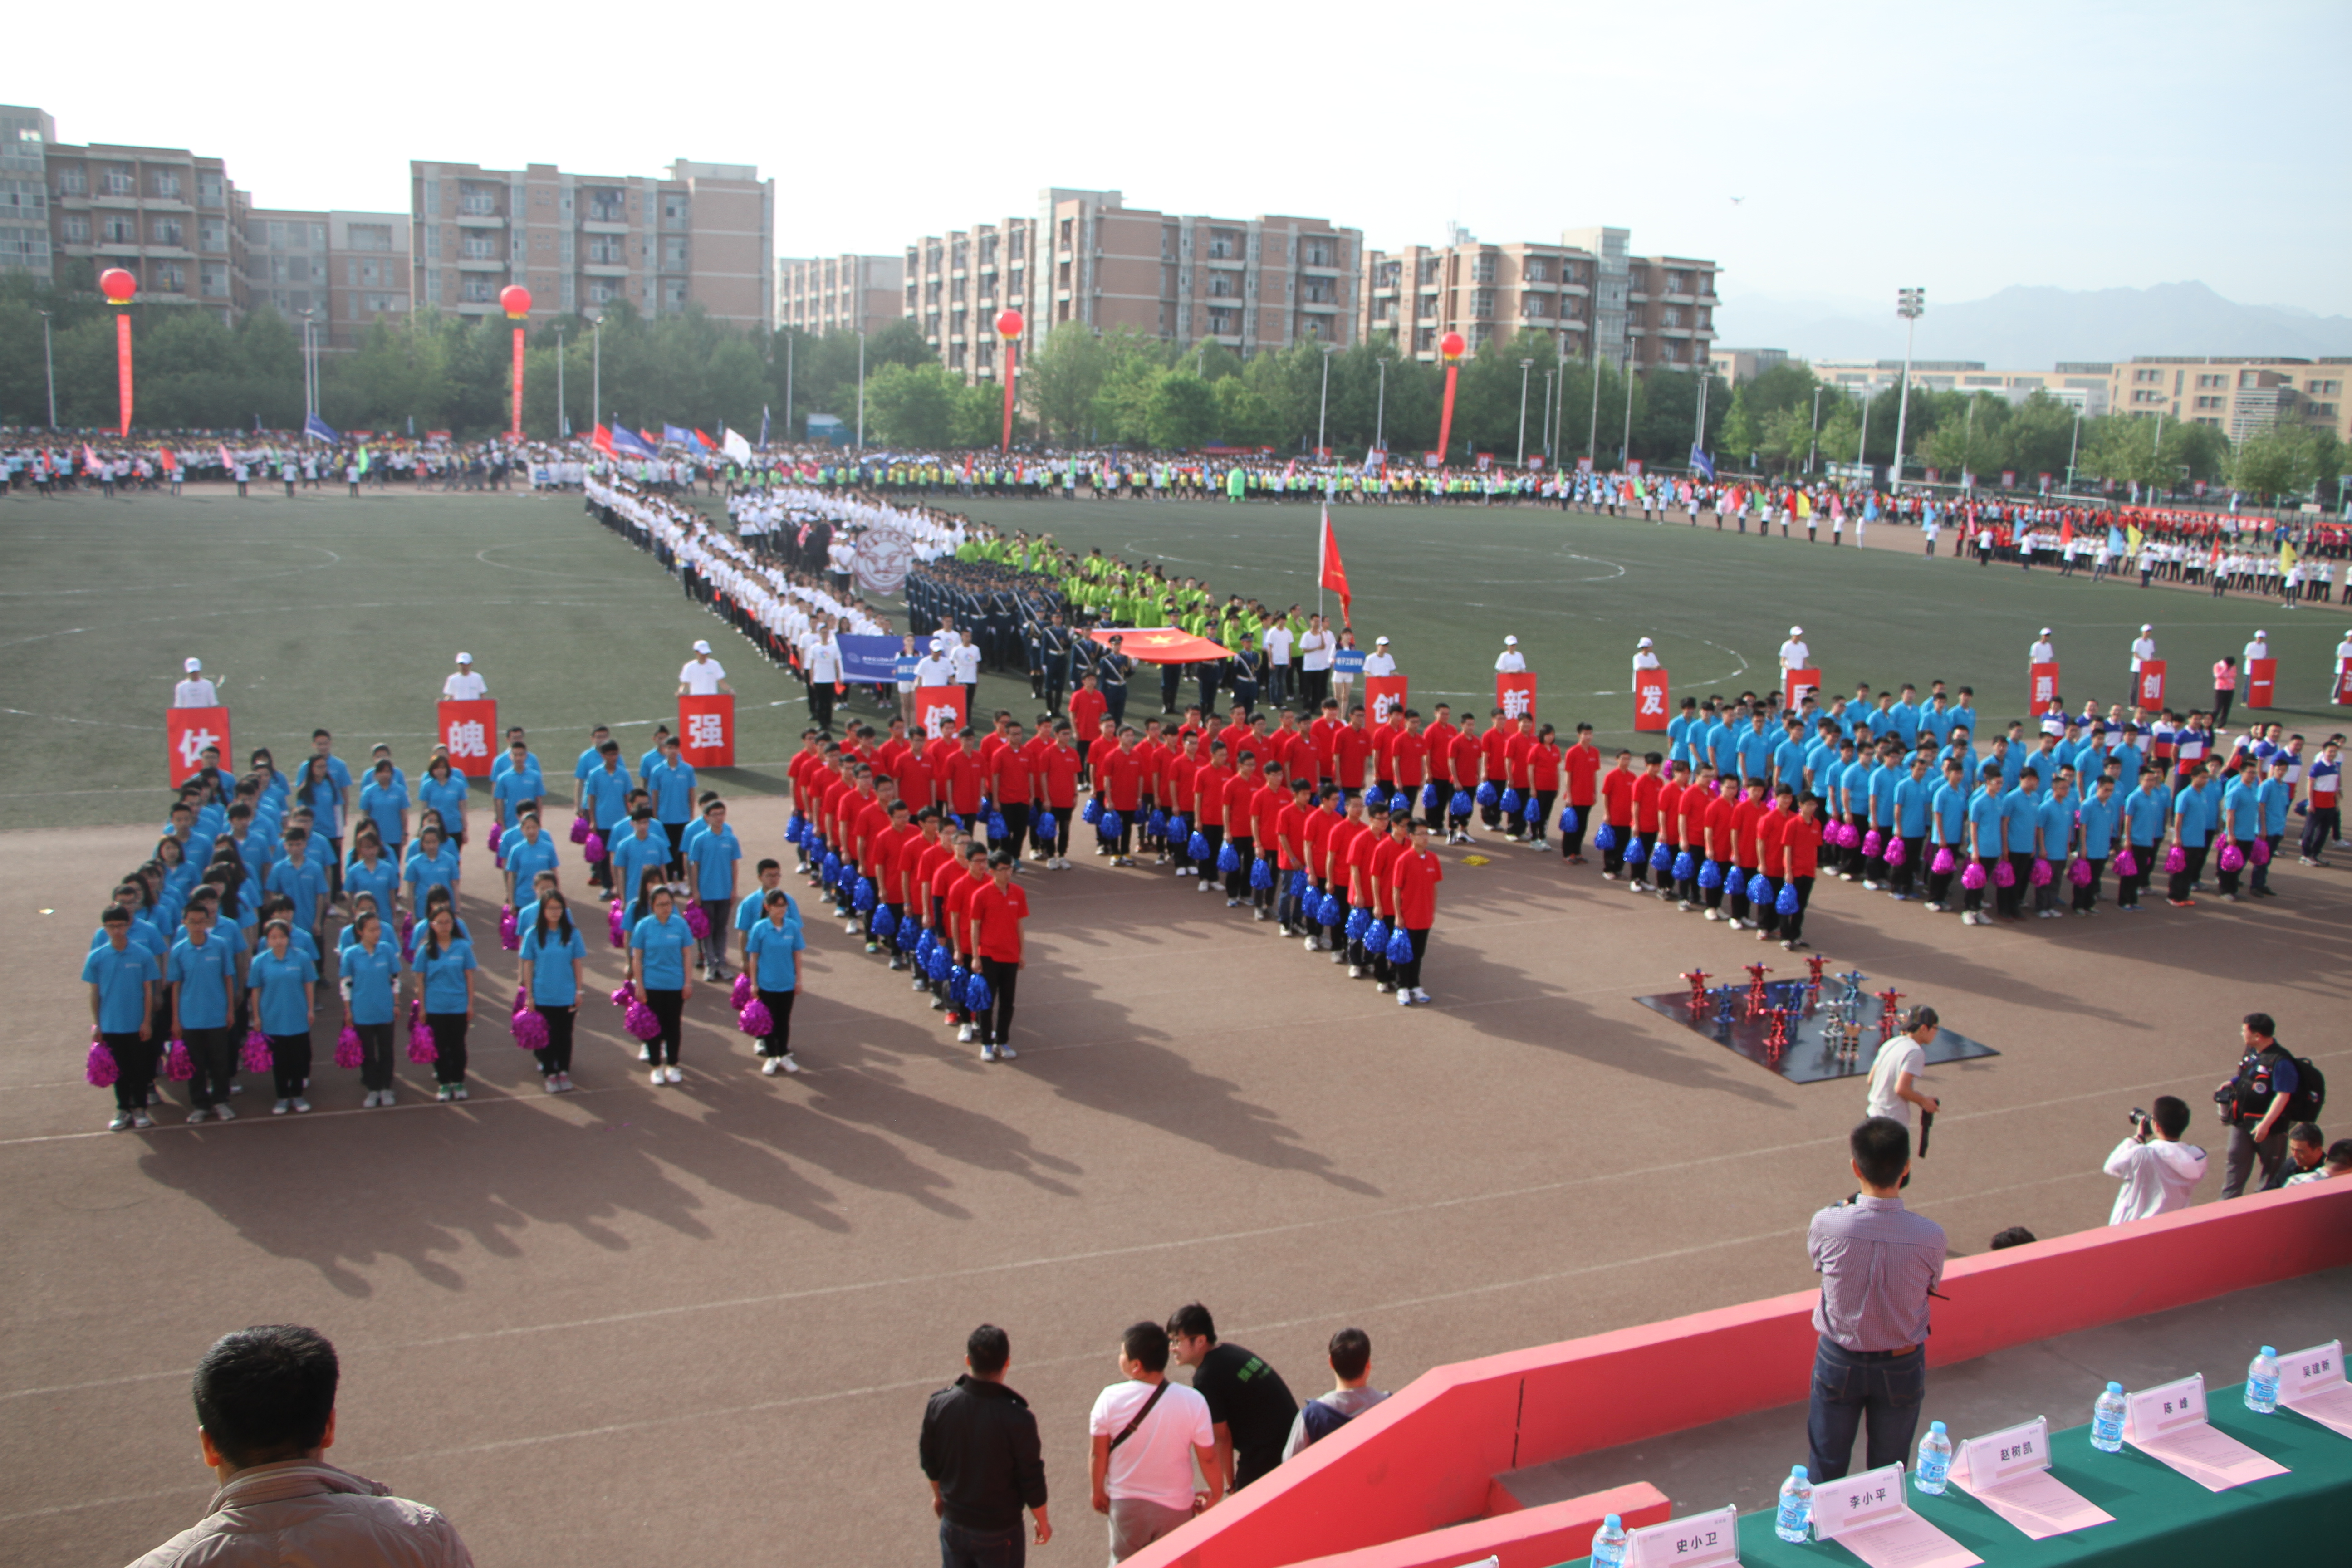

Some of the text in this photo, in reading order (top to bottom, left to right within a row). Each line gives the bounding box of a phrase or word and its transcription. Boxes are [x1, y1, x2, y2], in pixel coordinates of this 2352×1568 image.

[2143, 673, 2161, 698] 创
[1503, 688, 1530, 720] 新
[1640, 685, 1664, 715] 发
[448, 720, 488, 757] 魄
[688, 714, 725, 748] 强
[2303, 1358, 2330, 1378] 吴建新
[2163, 1396, 2188, 1415] 陈峰
[2000, 1441, 2033, 1461] 赵树凯
[1850, 1487, 1887, 1509] 李小平
[1676, 1532, 1718, 1554] 史小卫
